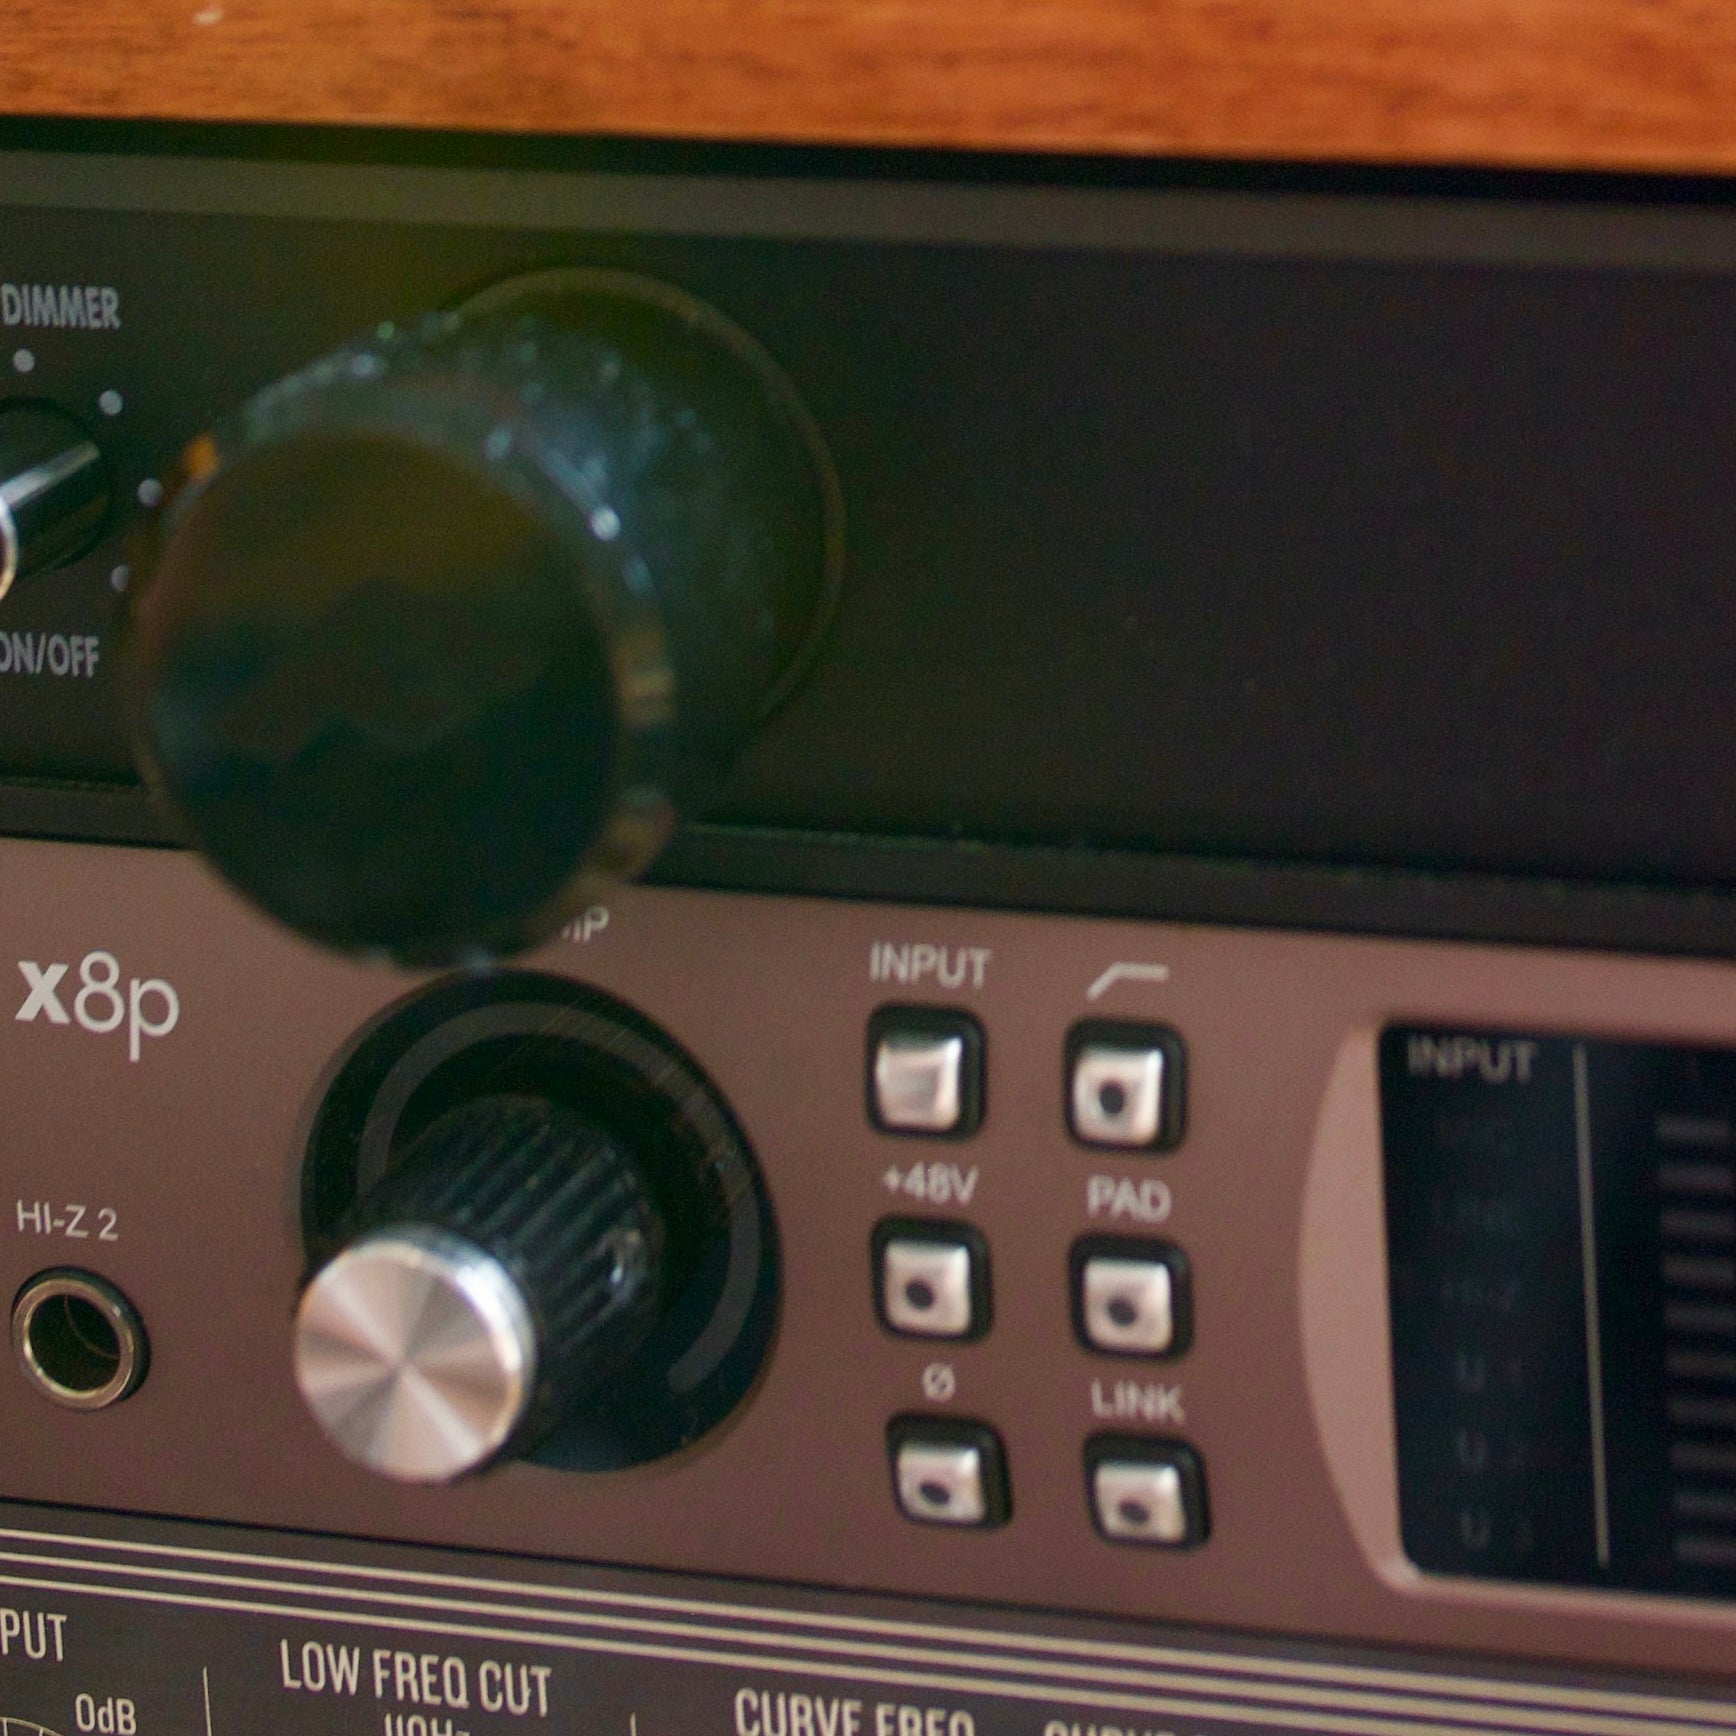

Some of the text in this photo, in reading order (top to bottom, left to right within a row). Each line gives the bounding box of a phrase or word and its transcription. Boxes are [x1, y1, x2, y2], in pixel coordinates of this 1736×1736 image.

[2, 283, 121, 328] DIMMER
[870, 942, 993, 989] INPUT
[15, 951, 180, 1062] x8p
[1408, 1036, 1538, 1084] INPUT
[883, 1162, 980, 1206] +48V
[1087, 1175, 1173, 1222] PAD
[17, 1199, 119, 1242] HI-Z 2
[1091, 1382, 1186, 1424] LINK
[280, 1639, 552, 1718] LOW FREQ CUT
[75, 1693, 137, 1735] 0dB
[735, 1687, 862, 1736] CURVE
